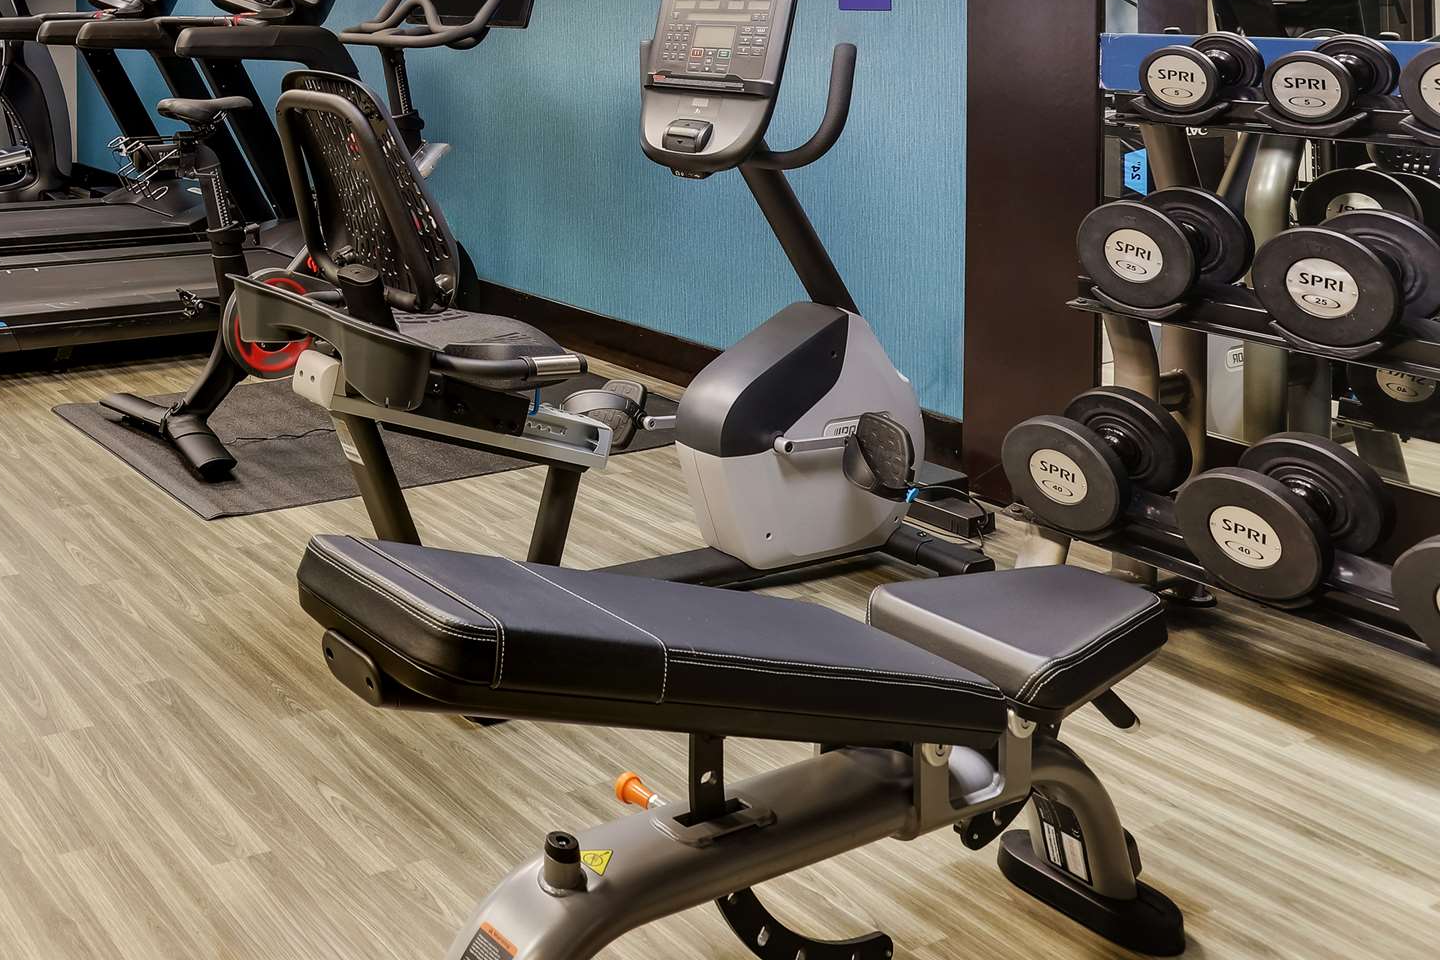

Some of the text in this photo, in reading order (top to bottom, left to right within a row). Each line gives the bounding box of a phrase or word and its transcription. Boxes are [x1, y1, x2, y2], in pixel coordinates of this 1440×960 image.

[1157, 68, 1195, 83] SPRI
[1283, 77, 1327, 91] SPRI
[1114, 240, 1151, 261] SPRI
[1126, 263, 1137, 272] 25
[1298, 272, 1343, 292] SPRI
[1315, 297, 1328, 306] 25
[1039, 460, 1075, 484] SPRI
[1052, 485, 1063, 493] 40
[1222, 518, 1266, 545] SPRI
[1238, 546, 1250, 555] 40
